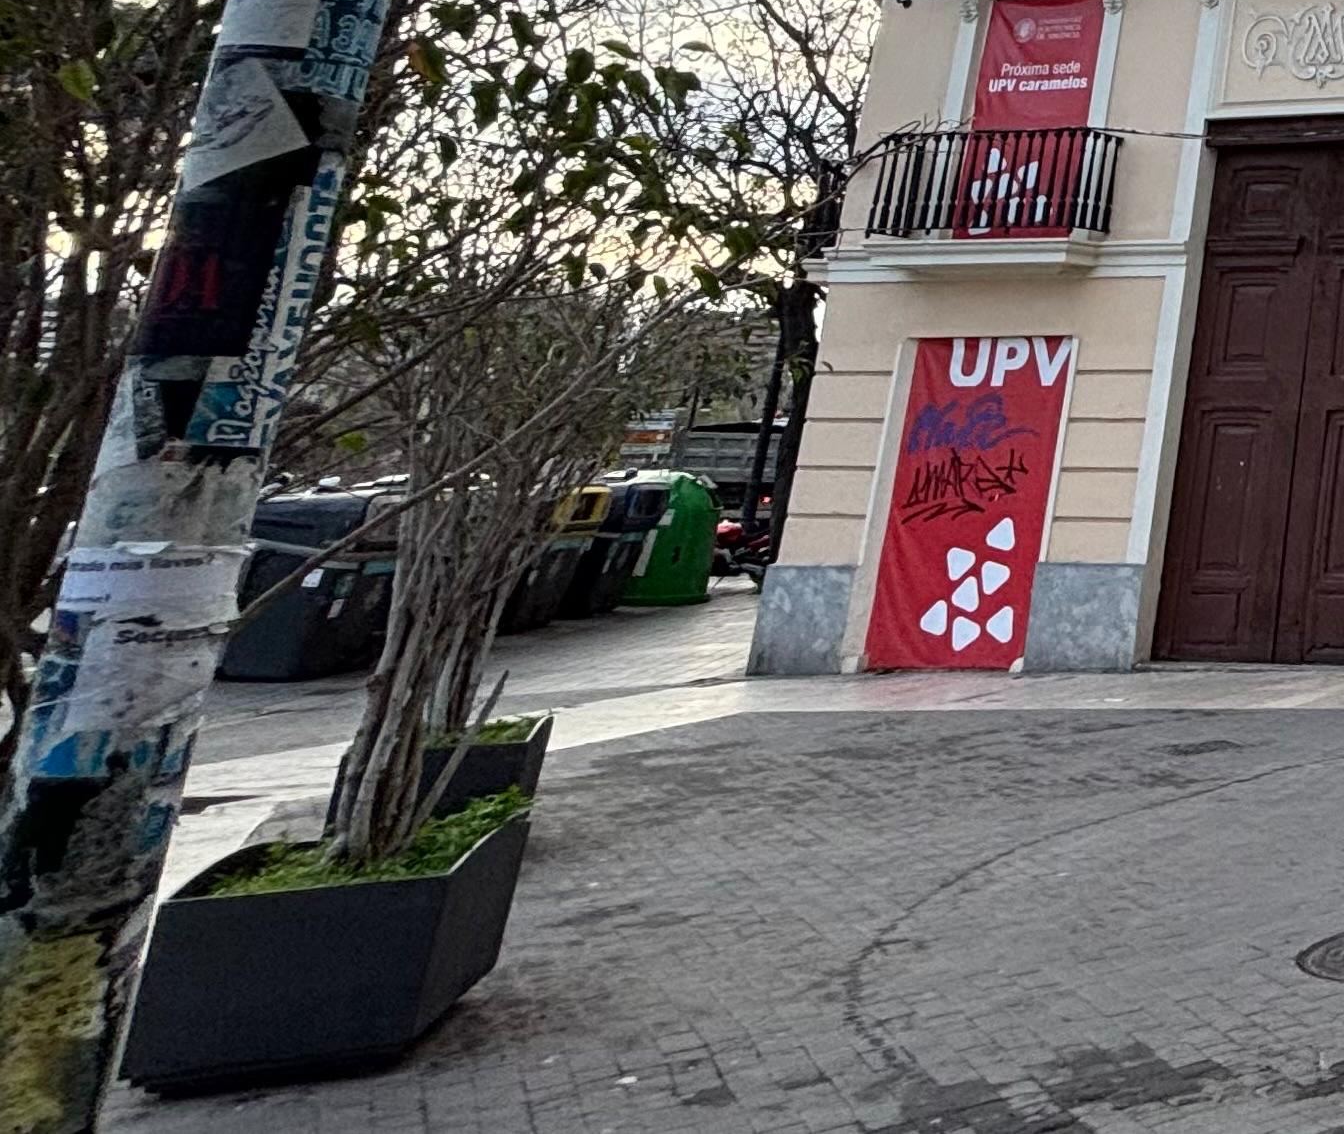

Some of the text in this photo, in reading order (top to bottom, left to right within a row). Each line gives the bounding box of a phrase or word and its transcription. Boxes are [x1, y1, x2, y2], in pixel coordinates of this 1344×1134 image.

[1001, 60, 1081, 77] Próxima sede
[988, 75, 1089, 93] UPV caramelos
[949, 337, 1073, 387] UPV
